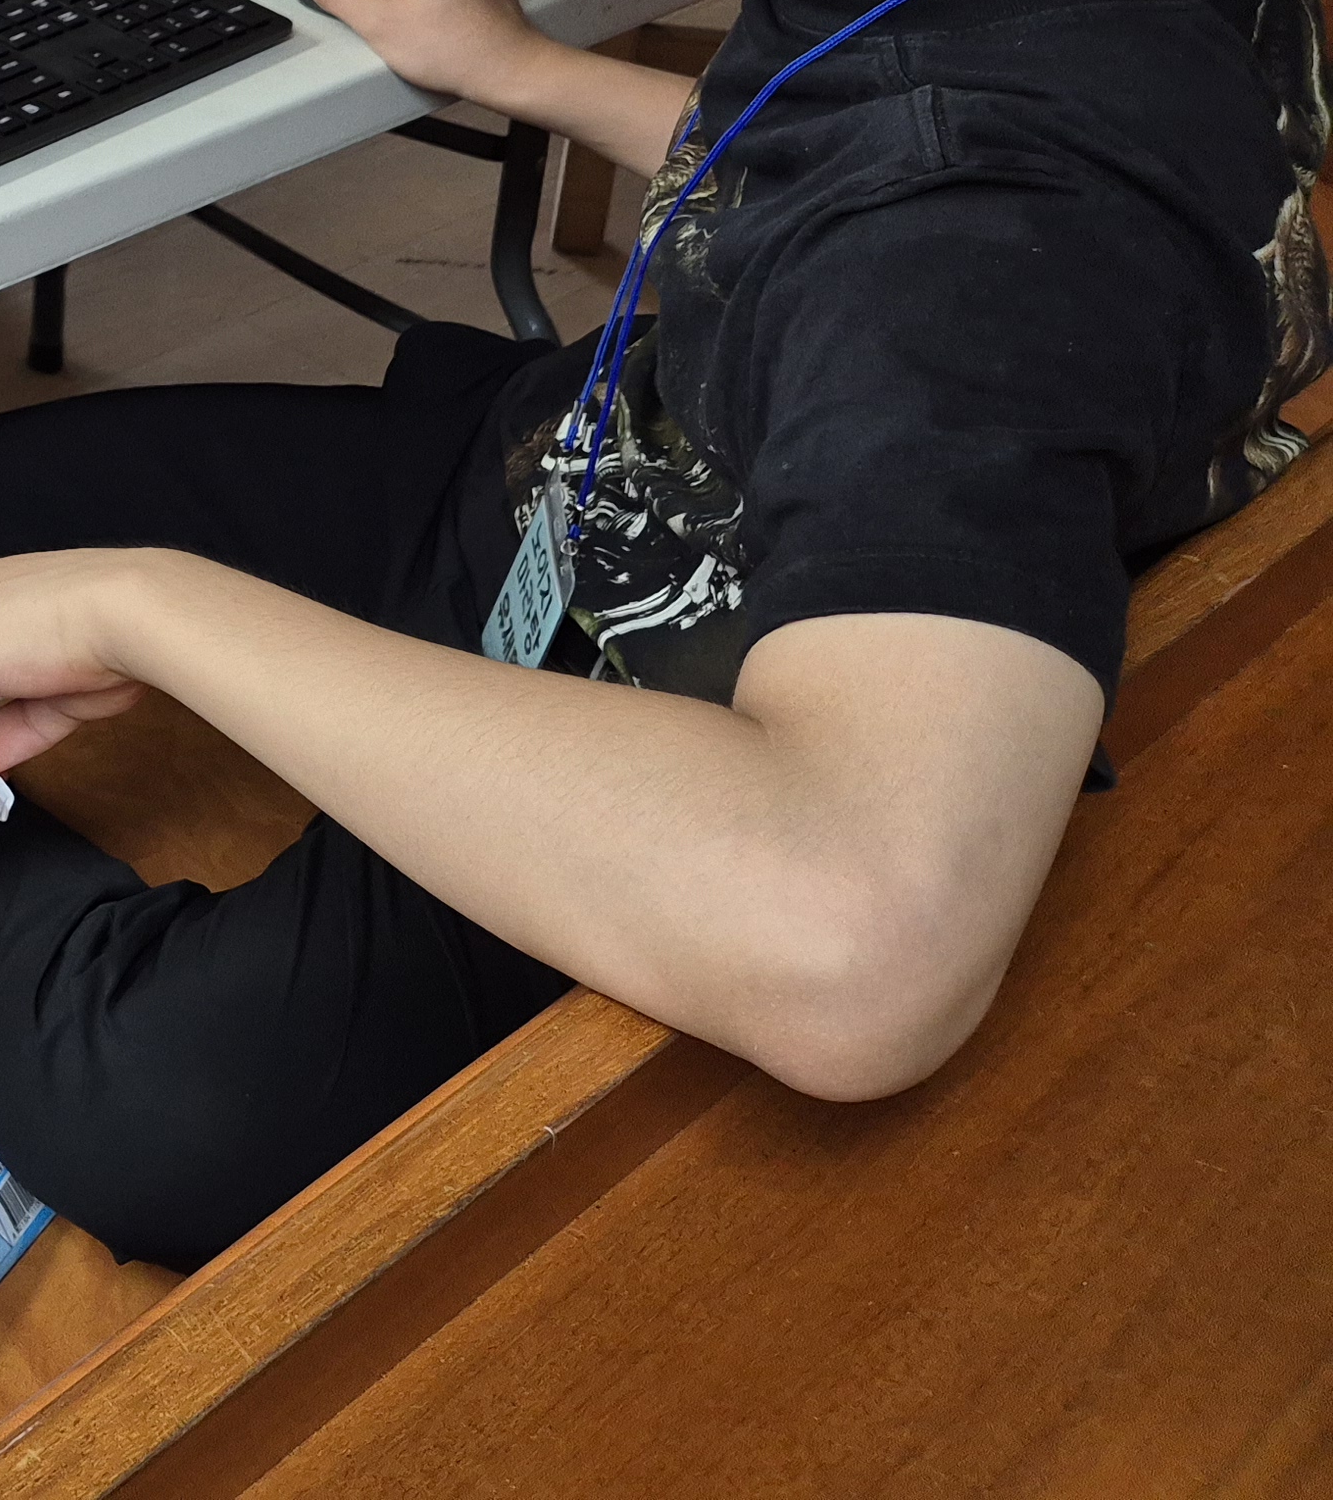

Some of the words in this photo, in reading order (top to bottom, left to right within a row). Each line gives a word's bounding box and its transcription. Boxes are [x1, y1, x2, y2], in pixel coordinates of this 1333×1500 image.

[517, 552, 541, 656] 마라탕
[531, 521, 553, 620] 노이지
[497, 591, 519, 664] 유재
